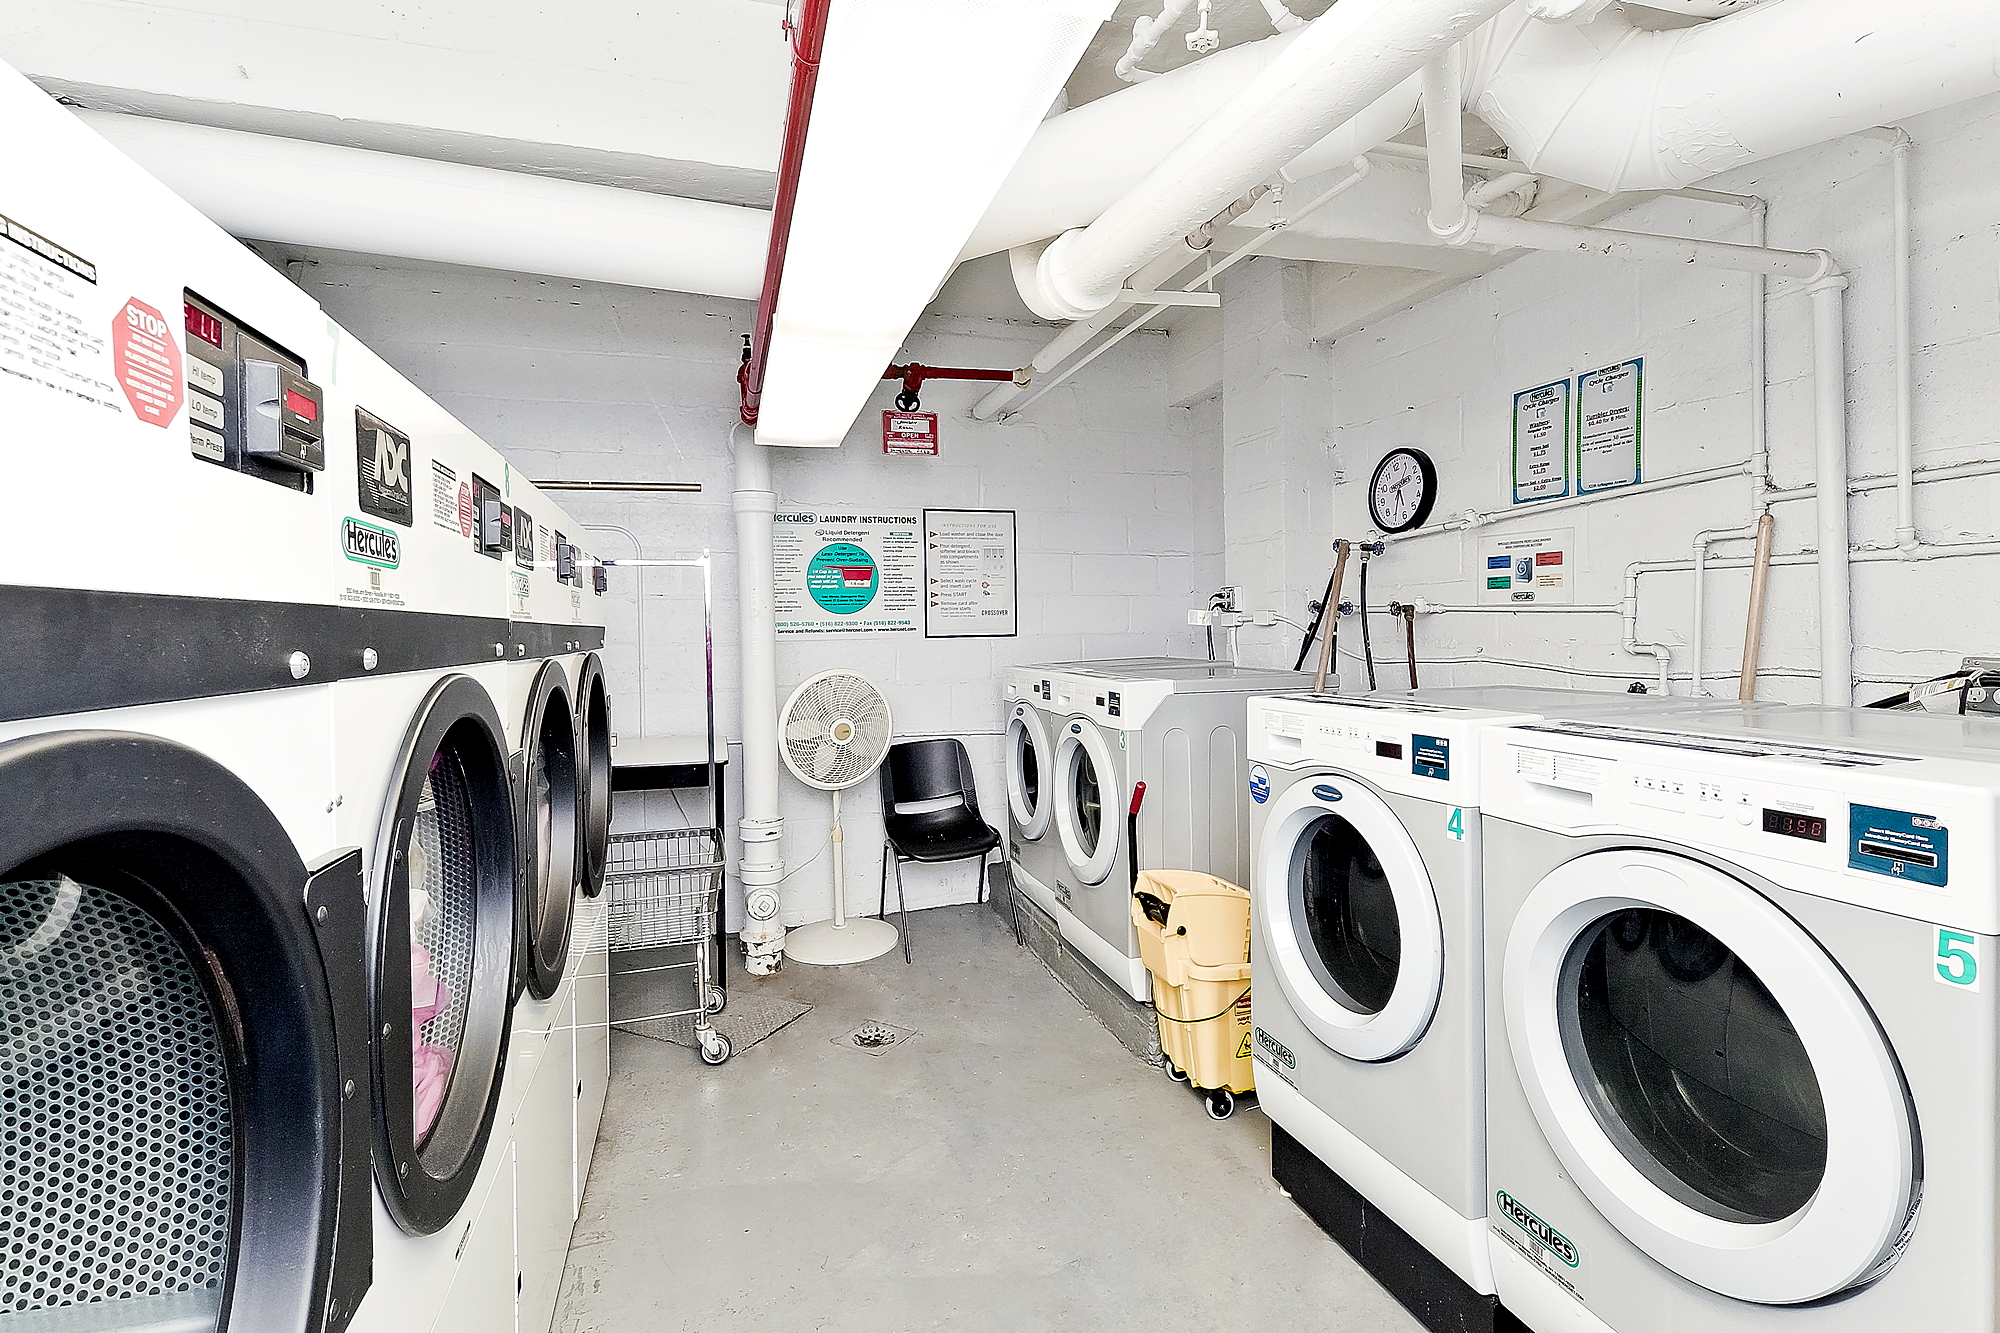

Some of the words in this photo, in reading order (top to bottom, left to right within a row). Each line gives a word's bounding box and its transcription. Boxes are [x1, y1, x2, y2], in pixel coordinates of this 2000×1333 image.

[126, 304, 168, 338] STOP
[326, 320, 339, 386] 7
[200, 370, 216, 386] temp
[1605, 372, 1629, 381] Charges
[192, 399, 202, 412] LO
[203, 404, 218, 420] temp
[1523, 403, 1536, 411] Cycle
[1538, 397, 1560, 406] Charges
[206, 438, 223, 453] Press
[1393, 462, 1400, 471] 12
[1412, 465, 1418, 474] 2
[505, 463, 510, 498] 8
[1385, 473, 1391, 481] 11
[1416, 475, 1421, 484] 3
[1381, 484, 1388, 493] 10
[1380, 498, 1386, 506] 9
[1411, 501, 1416, 510] 5
[1385, 508, 1390, 517] 8
[1402, 511, 1408, 519] 6
[860, 516, 917, 524] INSTRUCTIONS
[347, 520, 396, 560] Hercules
[1120, 730, 1125, 749] 3
[1448, 808, 1464, 840] 4
[1936, 929, 1977, 985] 5
[1259, 1030, 1292, 1064] Hercules
[1501, 1193, 1572, 1260] Hercules
